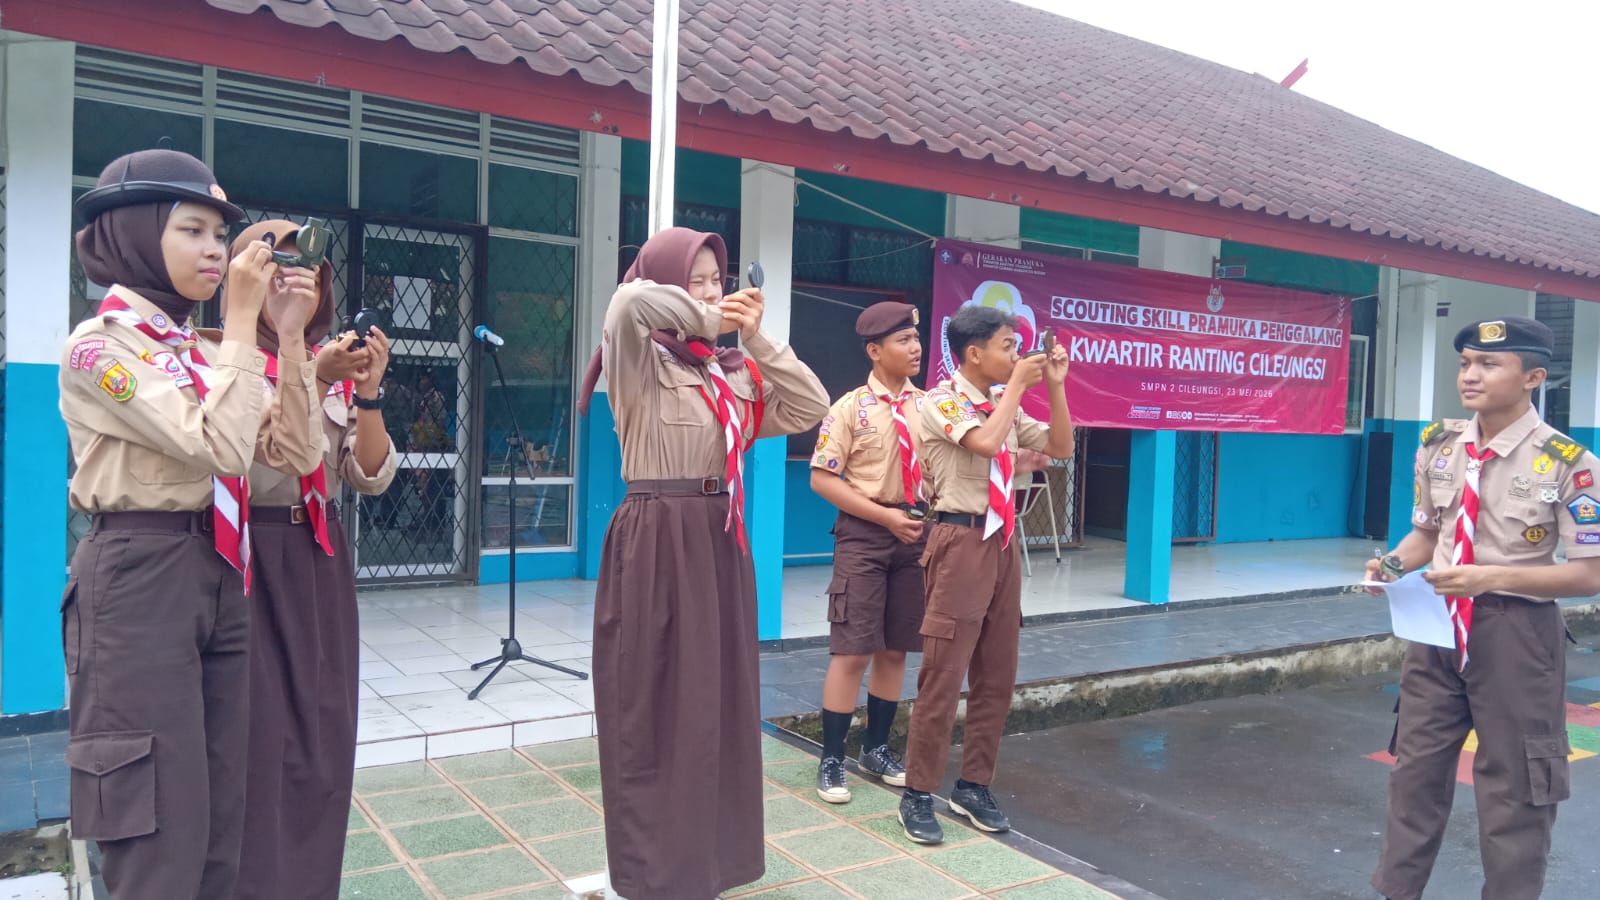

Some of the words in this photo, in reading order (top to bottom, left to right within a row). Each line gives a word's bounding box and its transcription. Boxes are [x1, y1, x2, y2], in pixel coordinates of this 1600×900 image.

[1052, 297, 1138, 325] SCOUTING
[1142, 308, 1185, 331] SKILL
[1188, 313, 1257, 338] PRAMUKA
[1260, 322, 1342, 346] PENGGALANG
[1070, 336, 1163, 368] KWARTIR
[1169, 345, 1245, 375] RANTING
[1249, 353, 1327, 380] CILEUNGSI
[1141, 382, 1167, 392] SMPN
[1170, 384, 1175, 393] 2
[1178, 384, 1224, 396] CILEUNGSI,
[1226, 387, 1236, 396] 23
[1239, 388, 1252, 397] MEI
